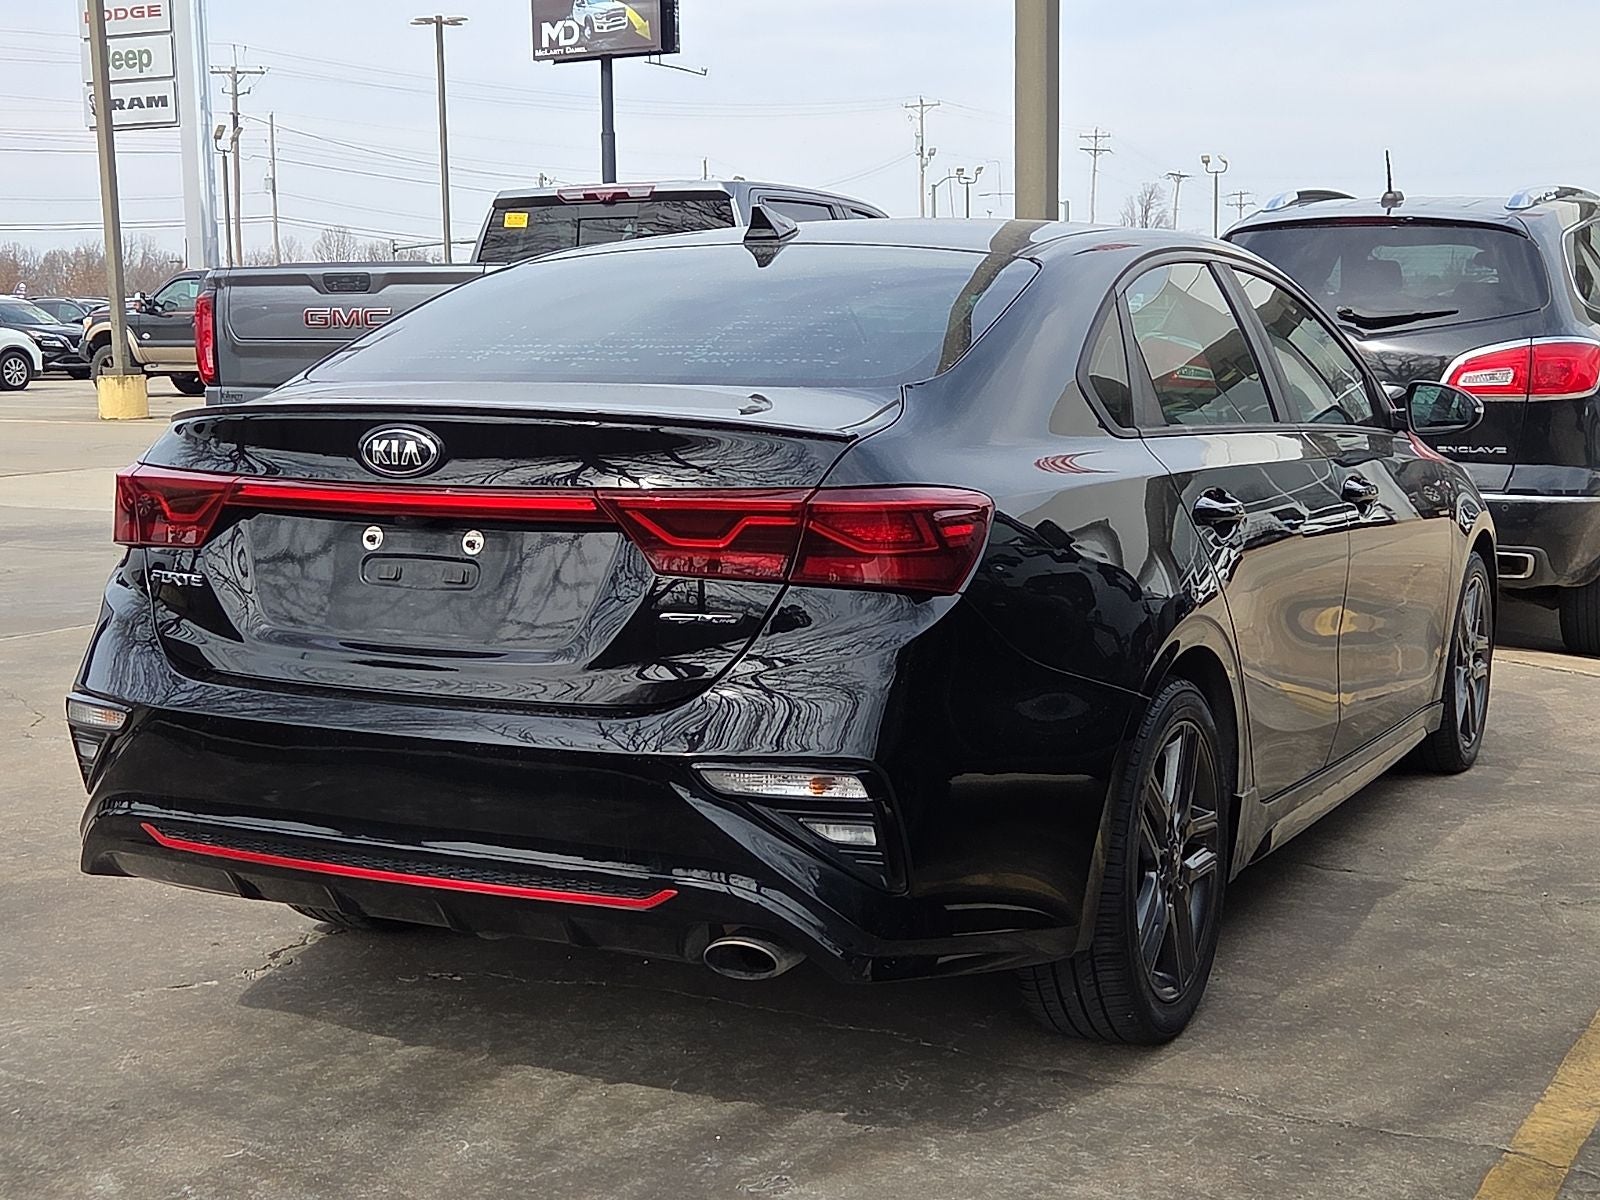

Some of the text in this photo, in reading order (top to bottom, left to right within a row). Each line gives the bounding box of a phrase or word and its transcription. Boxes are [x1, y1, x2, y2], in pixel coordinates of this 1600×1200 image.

[541, 19, 580, 48] MD
[110, 95, 168, 111] RAM
[303, 307, 392, 329] GMC
[372, 439, 422, 466] KIA
[1436, 445, 1508, 454] ENCLAVE
[150, 569, 203, 587] FORTE
